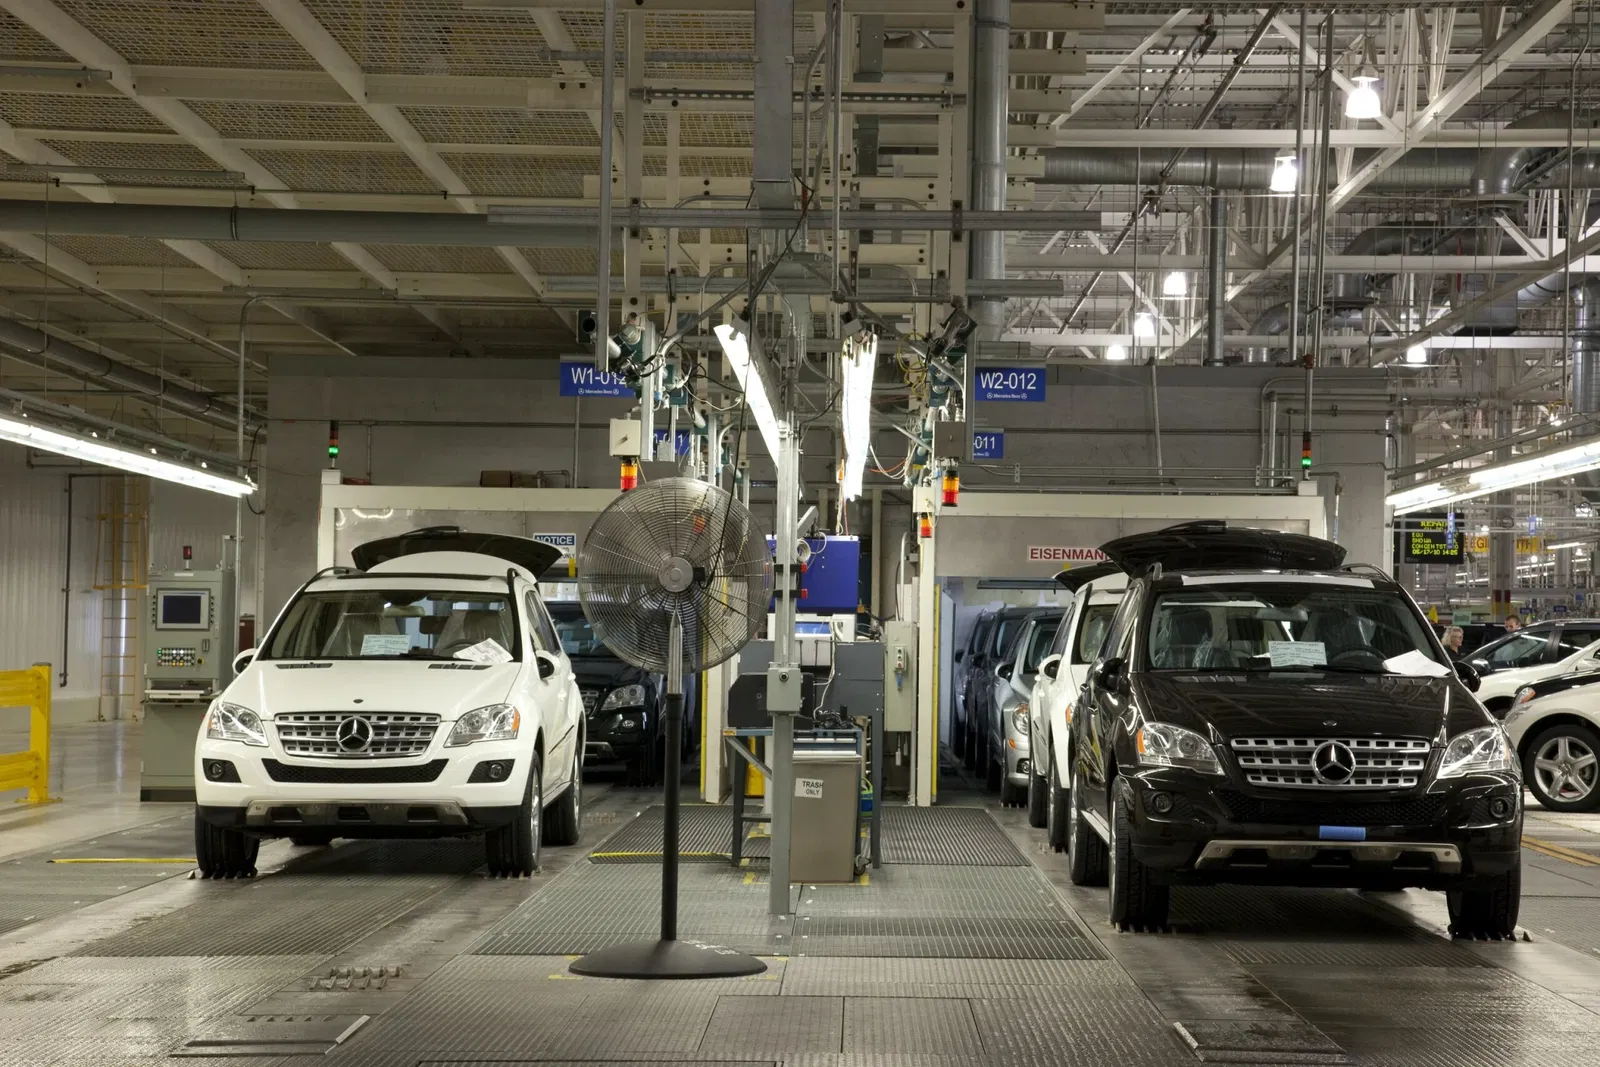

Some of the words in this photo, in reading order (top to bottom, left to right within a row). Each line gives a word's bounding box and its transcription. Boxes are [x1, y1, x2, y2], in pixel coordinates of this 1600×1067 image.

[980, 372, 1037, 390] W2-012
[536, 536, 573, 545] NOTICE
[1030, 548, 1108, 560] EISENMAN
[802, 780, 824, 789] TRASH
[805, 788, 821, 796] ONLY
